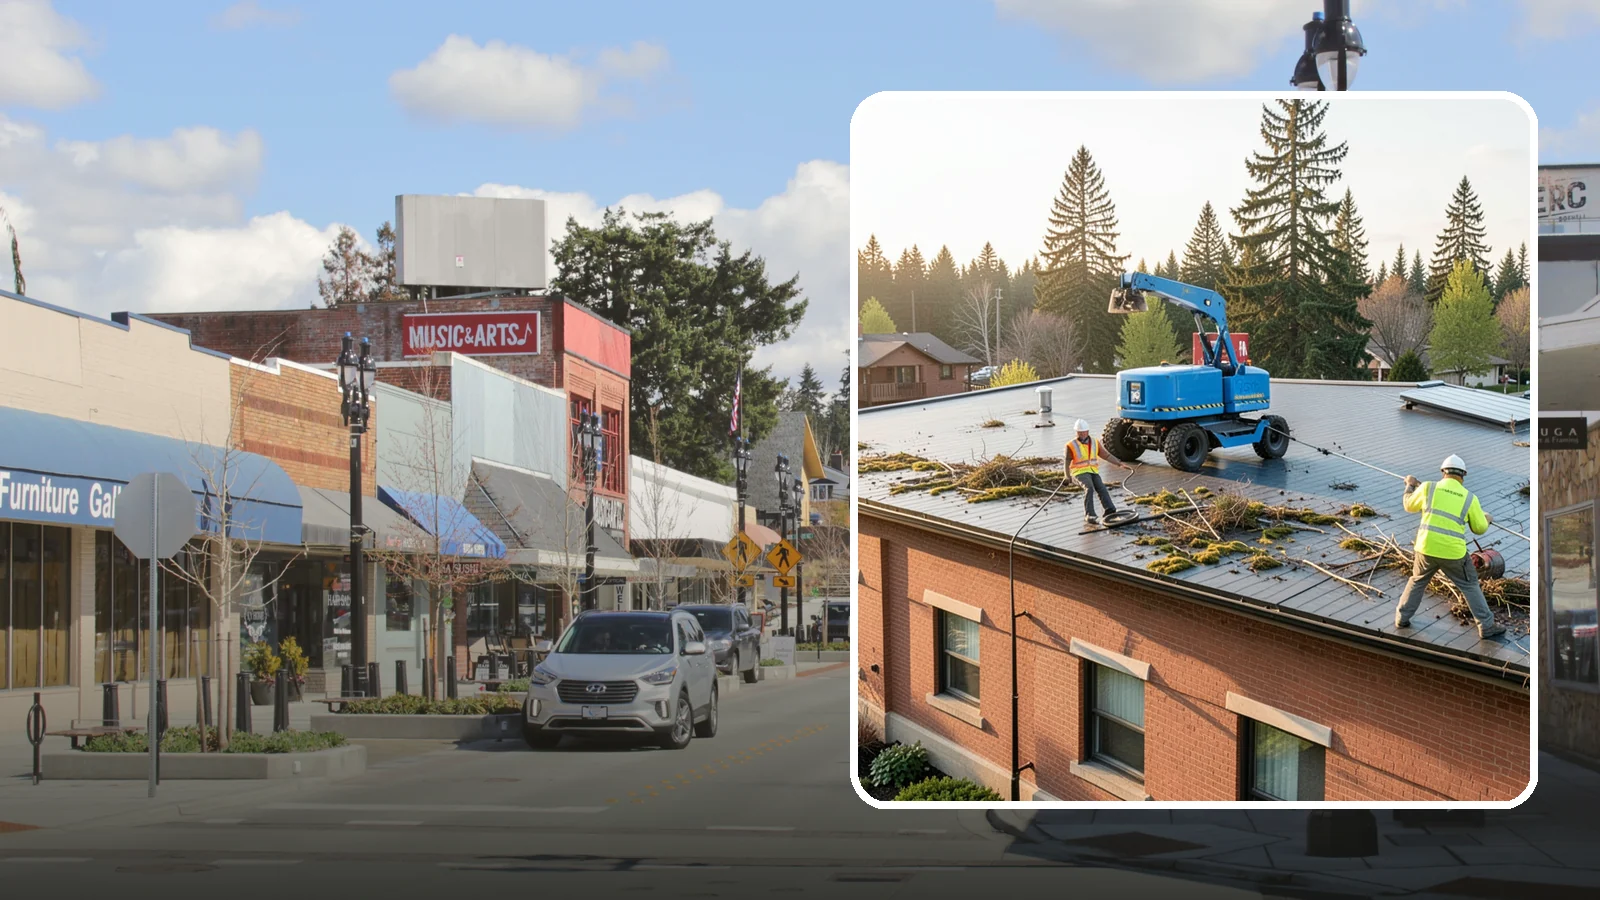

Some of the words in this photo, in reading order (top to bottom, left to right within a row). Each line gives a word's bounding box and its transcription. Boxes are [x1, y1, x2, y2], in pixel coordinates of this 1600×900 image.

[409, 323, 519, 348] MUSIC&ARTS
[1540, 428, 1578, 437] UGA
[1551, 436, 1580, 445] Framing
[0, 471, 79, 515] Furniture
[90, 482, 122, 519] Gal
[453, 562, 480, 574] SUSHI
